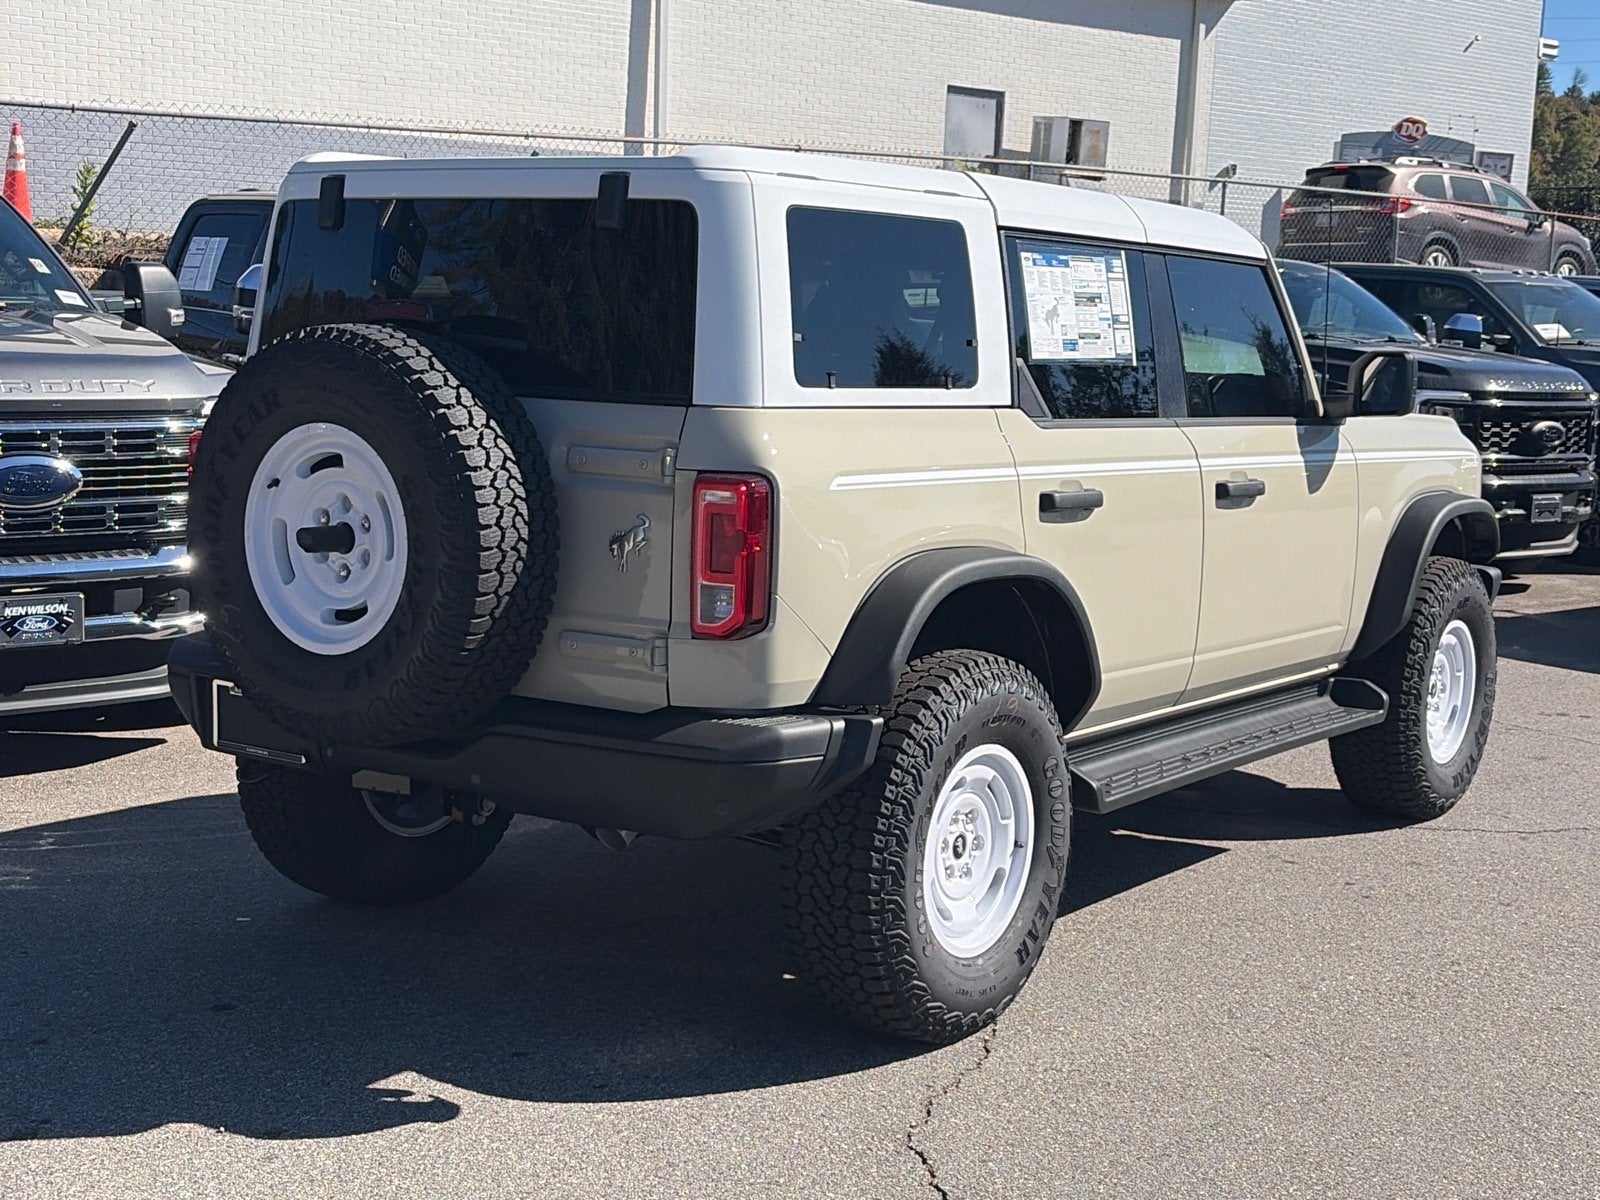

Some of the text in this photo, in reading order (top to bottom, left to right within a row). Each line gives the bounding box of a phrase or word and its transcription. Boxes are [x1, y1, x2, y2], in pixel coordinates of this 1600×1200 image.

[1399, 121, 1425, 139] DQ
[39, 379, 156, 394] DUTY
[4, 603, 69, 617] KEN WILSON
[22, 616, 50, 630] Ford
